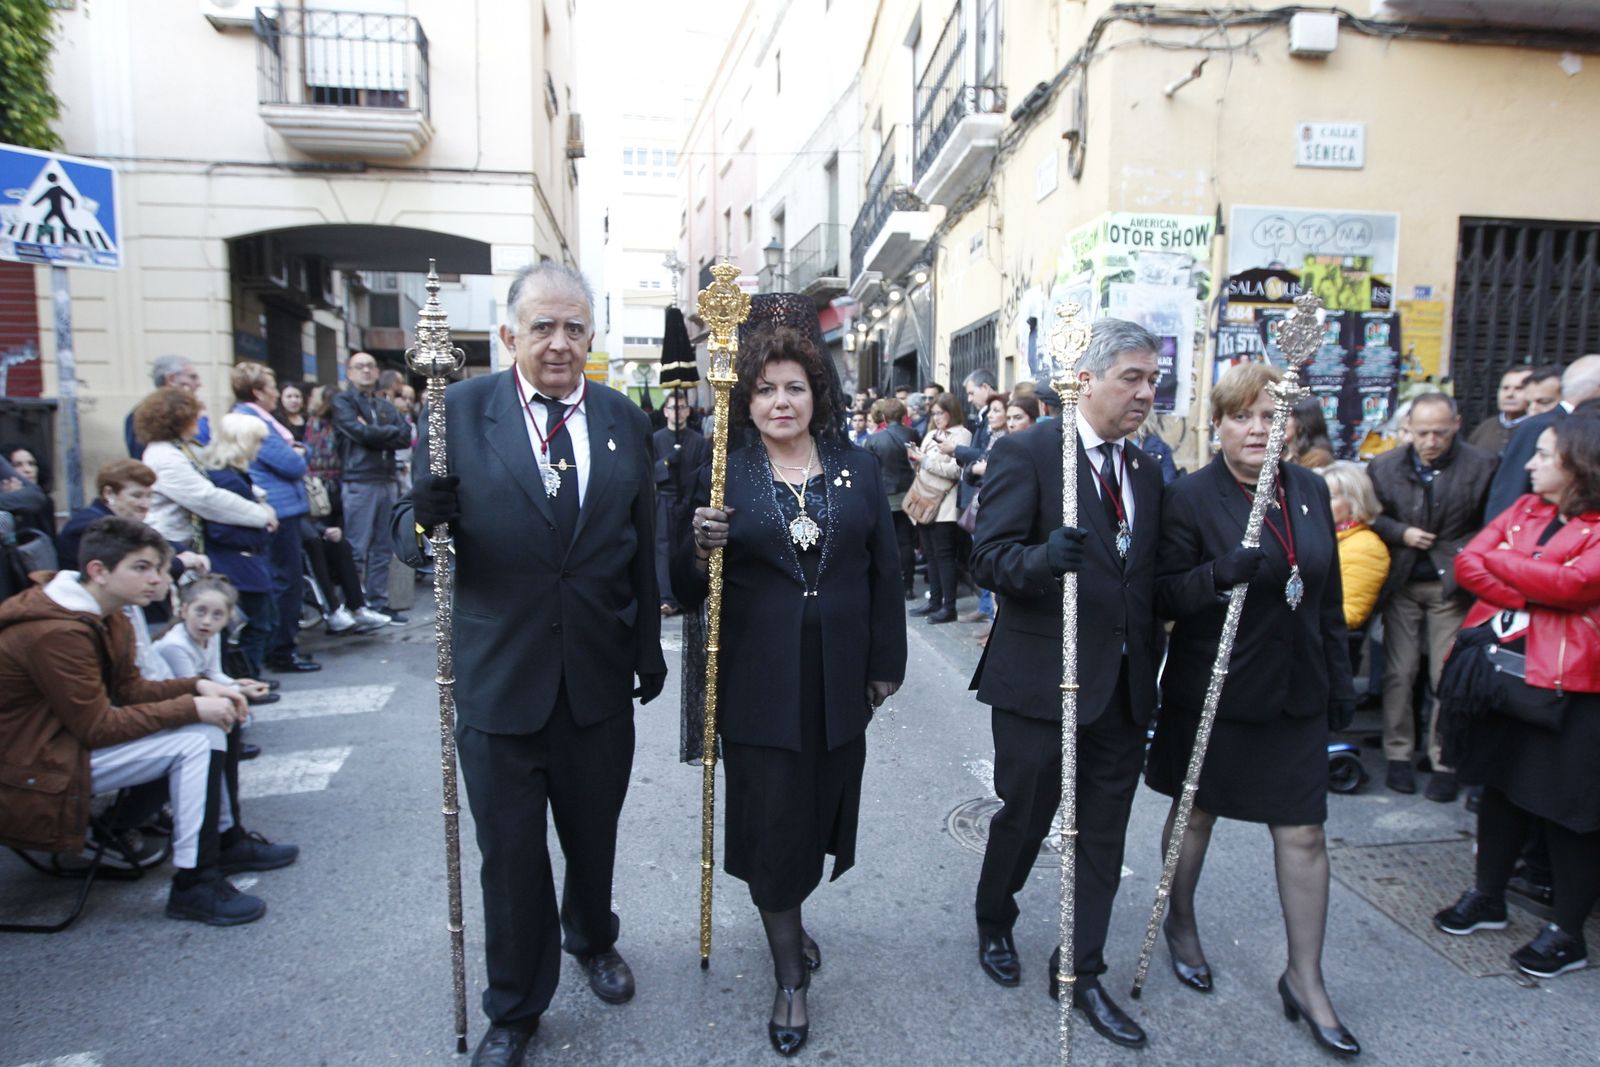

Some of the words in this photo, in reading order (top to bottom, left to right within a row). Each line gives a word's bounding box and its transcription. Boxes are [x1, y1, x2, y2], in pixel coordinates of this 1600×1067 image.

[1130, 218, 1179, 229] AMERICAN
[1161, 221, 1211, 248] SHOW
[1229, 280, 1265, 297] SALA
